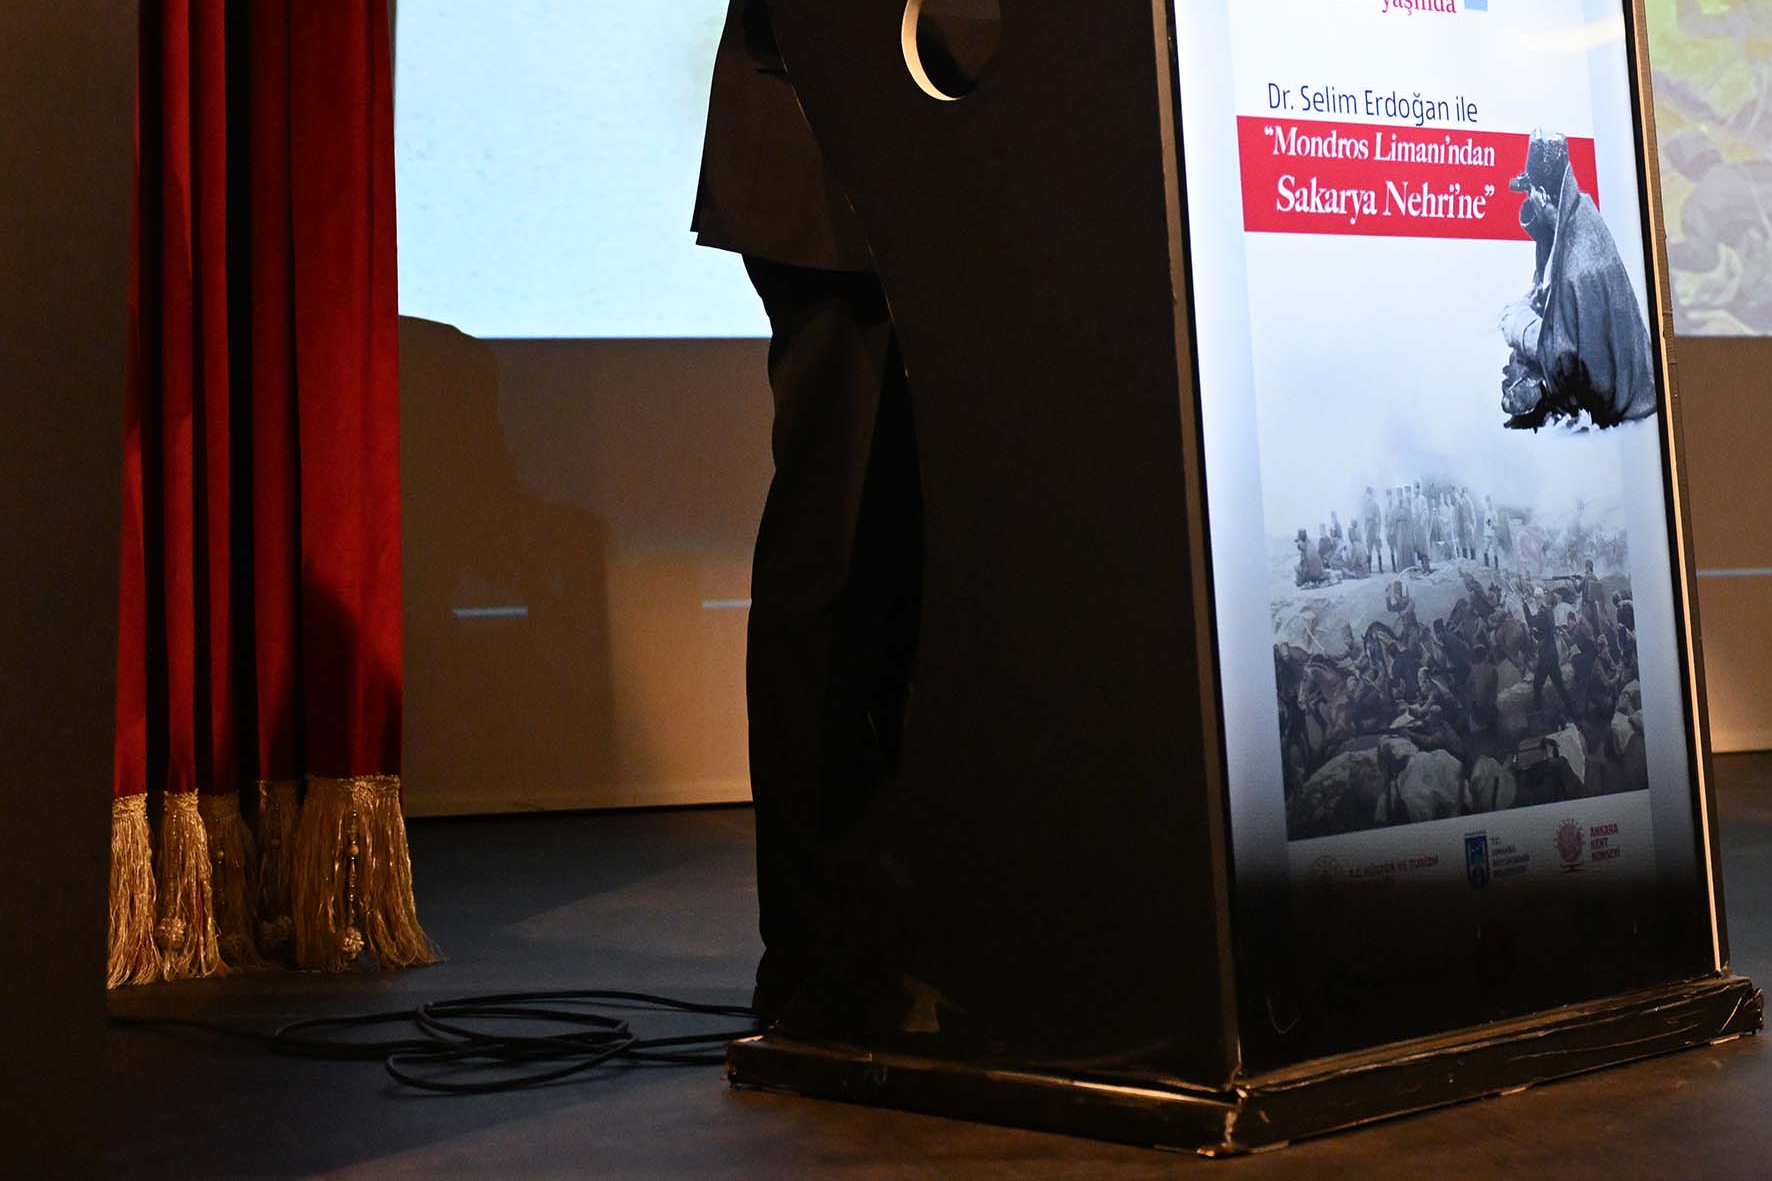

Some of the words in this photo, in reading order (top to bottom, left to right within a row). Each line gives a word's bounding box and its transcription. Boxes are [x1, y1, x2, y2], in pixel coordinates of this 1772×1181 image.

[1268, 82, 1294, 111] Dr.
[1300, 85, 1357, 116] Selim
[1365, 89, 1449, 127] Erdoğan
[1455, 96, 1478, 123] ile
[1276, 174, 1377, 225] Sakarya
